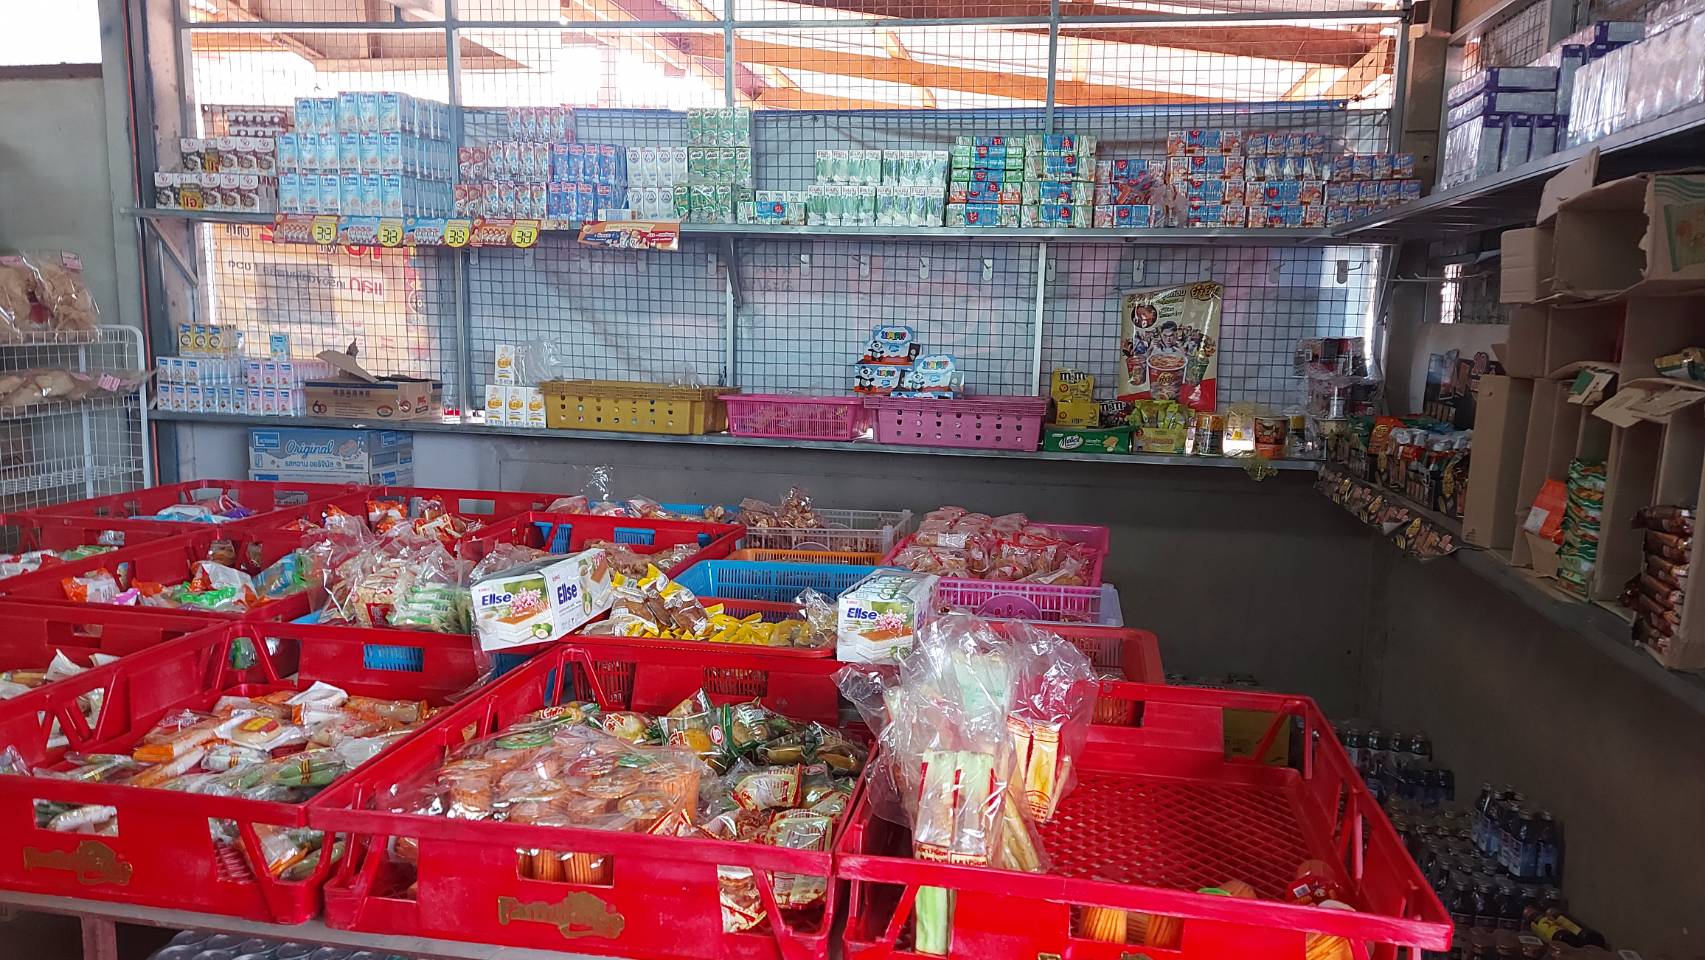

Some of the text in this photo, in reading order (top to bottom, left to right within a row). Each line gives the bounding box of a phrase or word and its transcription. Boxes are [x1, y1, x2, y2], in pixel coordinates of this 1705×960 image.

[286, 440, 334, 458] Original
[481, 593, 512, 606] Ellse
[557, 582, 578, 605] Ellse
[846, 607, 878, 620] Ellse
